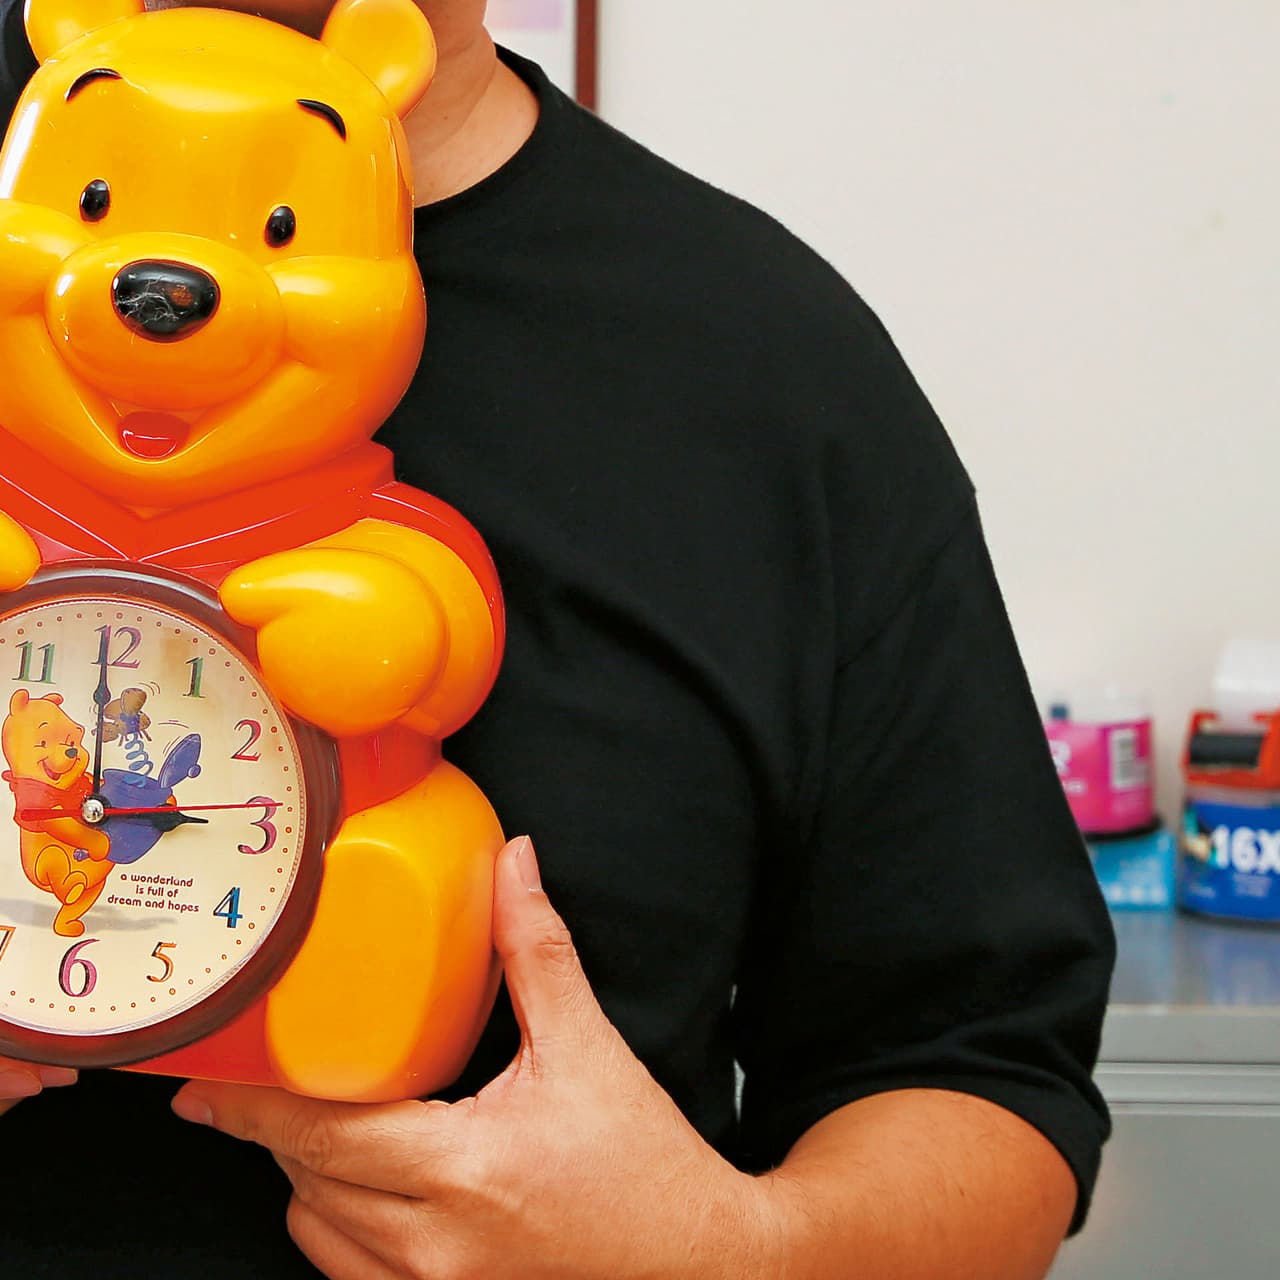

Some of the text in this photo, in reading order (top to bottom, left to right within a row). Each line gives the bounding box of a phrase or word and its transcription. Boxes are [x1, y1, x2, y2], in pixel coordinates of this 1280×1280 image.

[12, 641, 56, 685] 11
[91, 624, 141, 669] 12
[182, 656, 207, 699] 1
[231, 719, 262, 762] 2
[237, 796, 278, 855] 3
[107, 894, 200, 913] dream and hopes
[135, 885, 179, 898] is full of
[213, 887, 243, 929] 4
[58, 938, 100, 998] 6
[146, 941, 177, 983] 5
